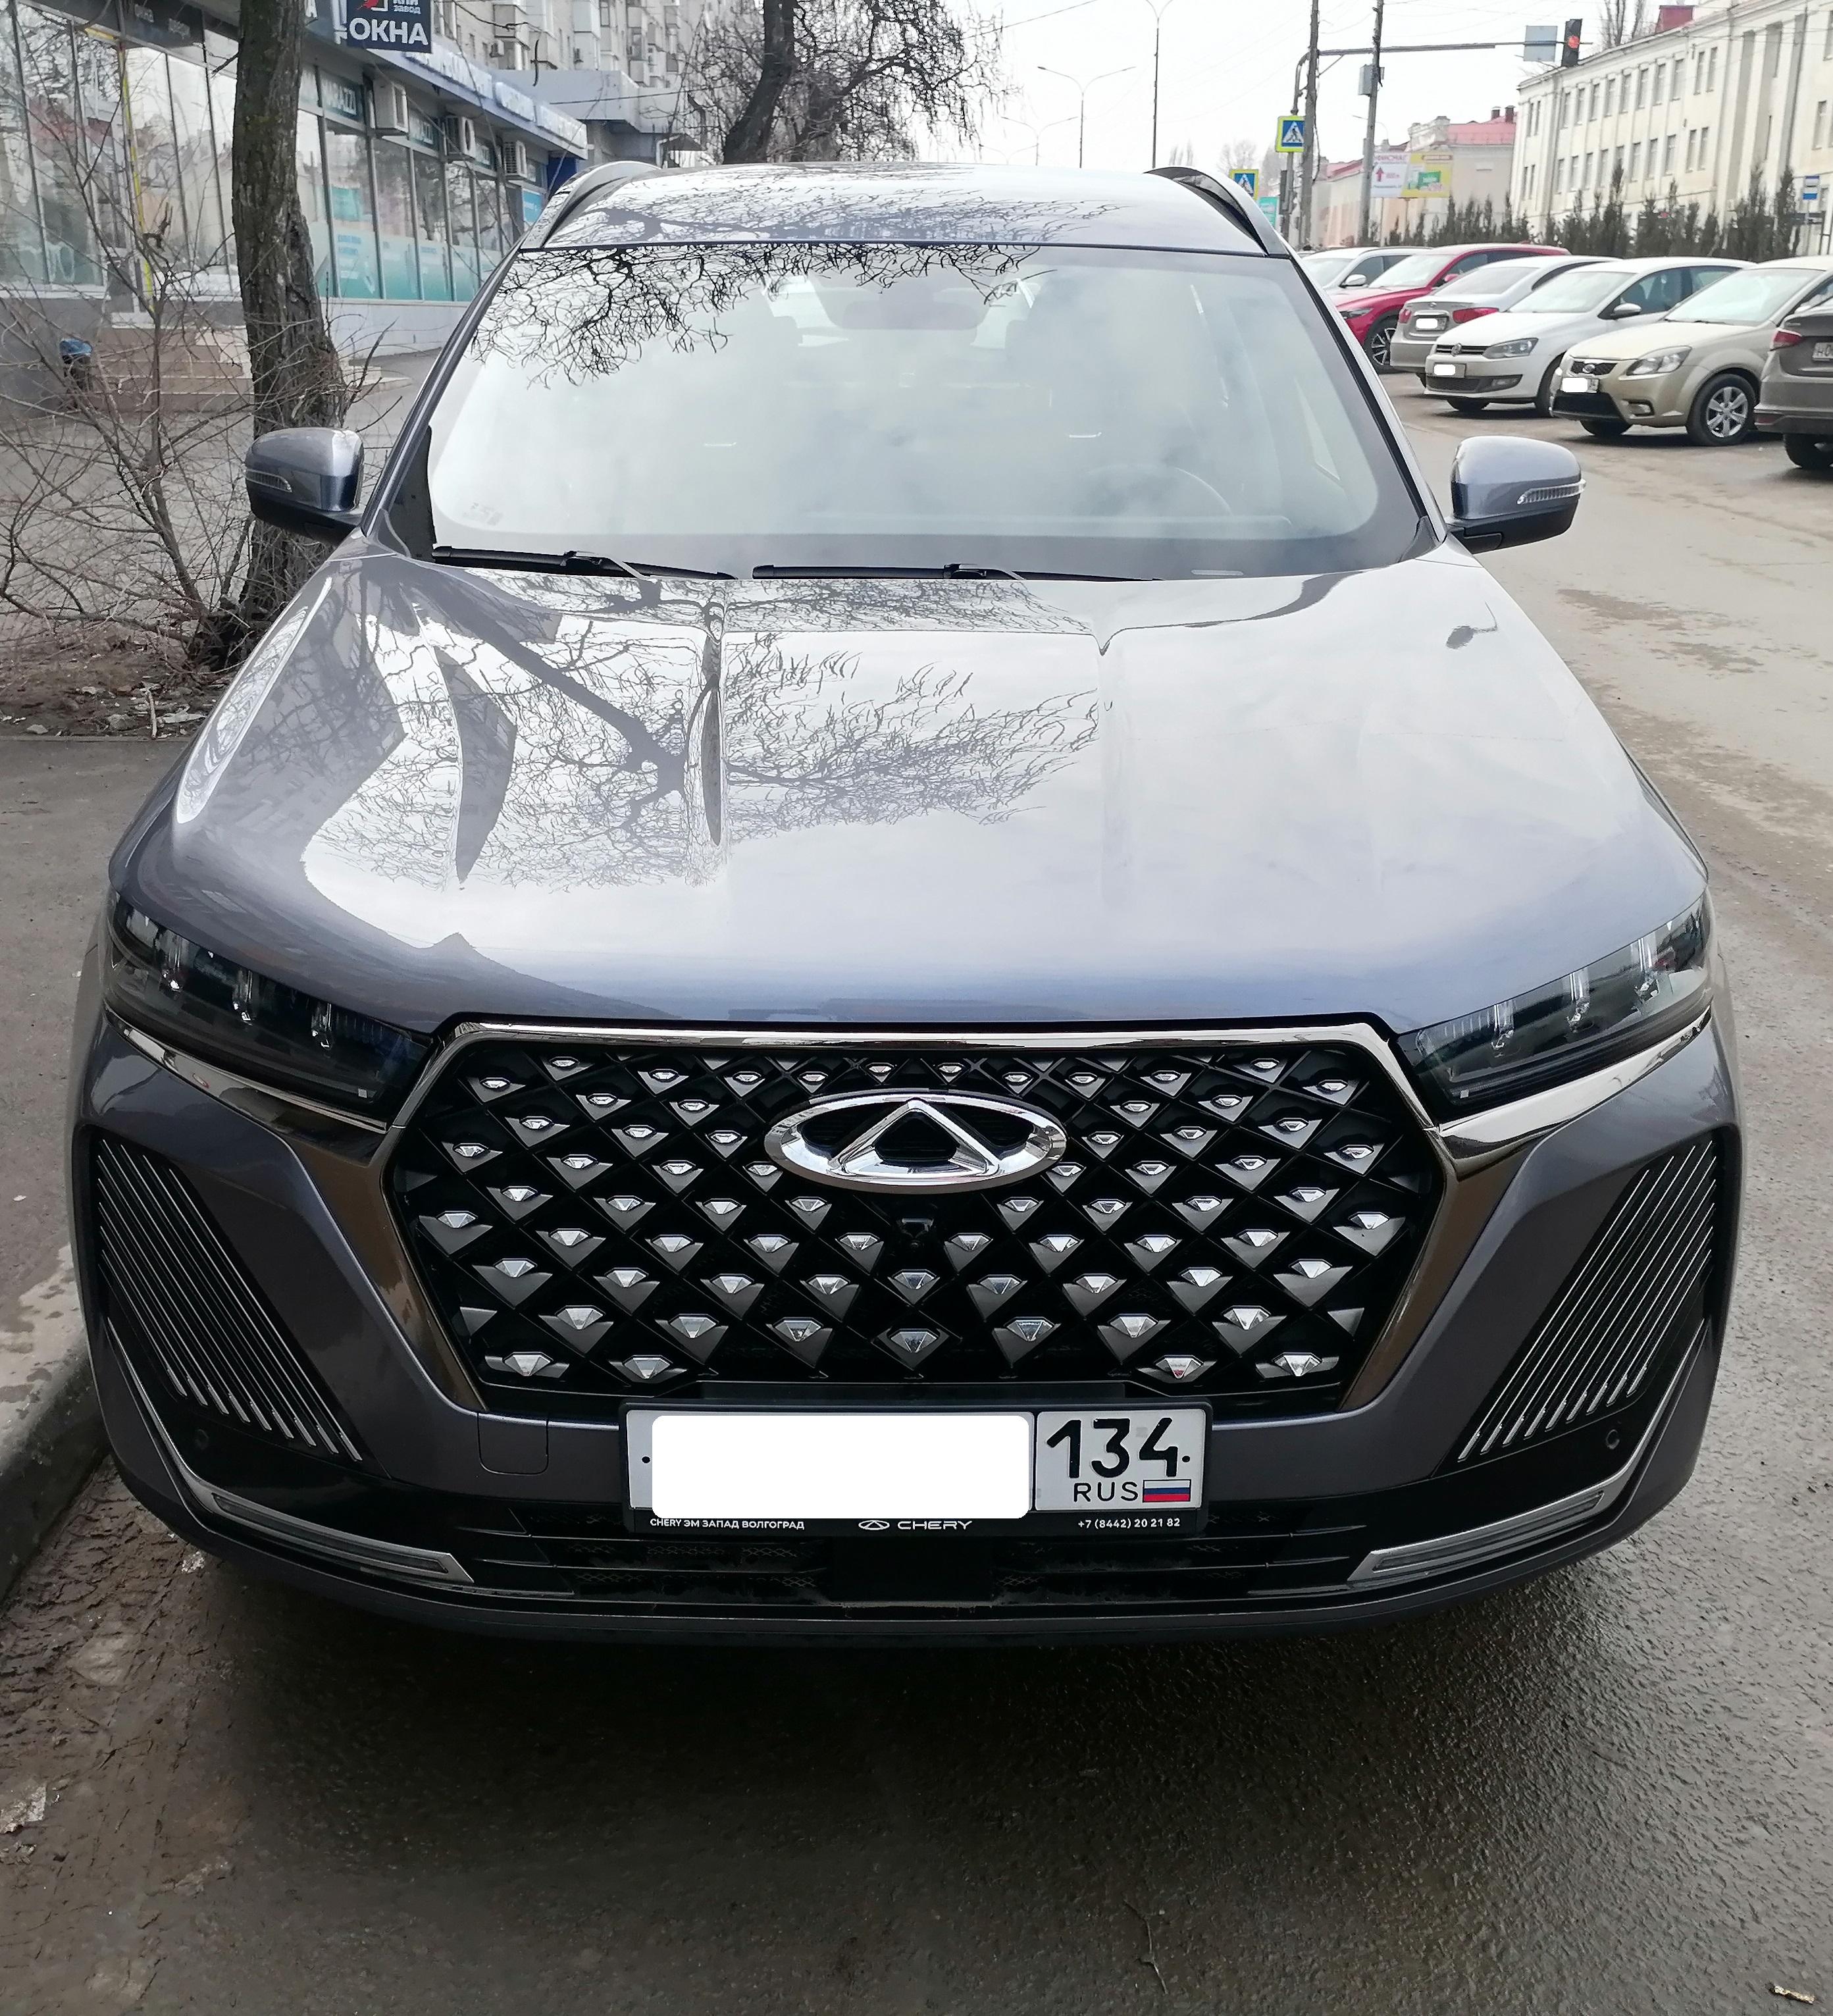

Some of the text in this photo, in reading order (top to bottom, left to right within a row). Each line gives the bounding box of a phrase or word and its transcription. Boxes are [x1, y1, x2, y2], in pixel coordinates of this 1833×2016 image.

[349, 17, 428, 45] ОКНА
[1046, 1417, 1178, 1478] 134
[1073, 1482, 1139, 1502] RUS
[650, 1518, 682, 1527] CHERY
[702, 1520, 739, 1529] ЗАПАД
[742, 1520, 805, 1530] ВОЛГОГРАД
[897, 1520, 973, 1530] CHERY
[1078, 1518, 1180, 1529] +7 (8442) 20 21 82
